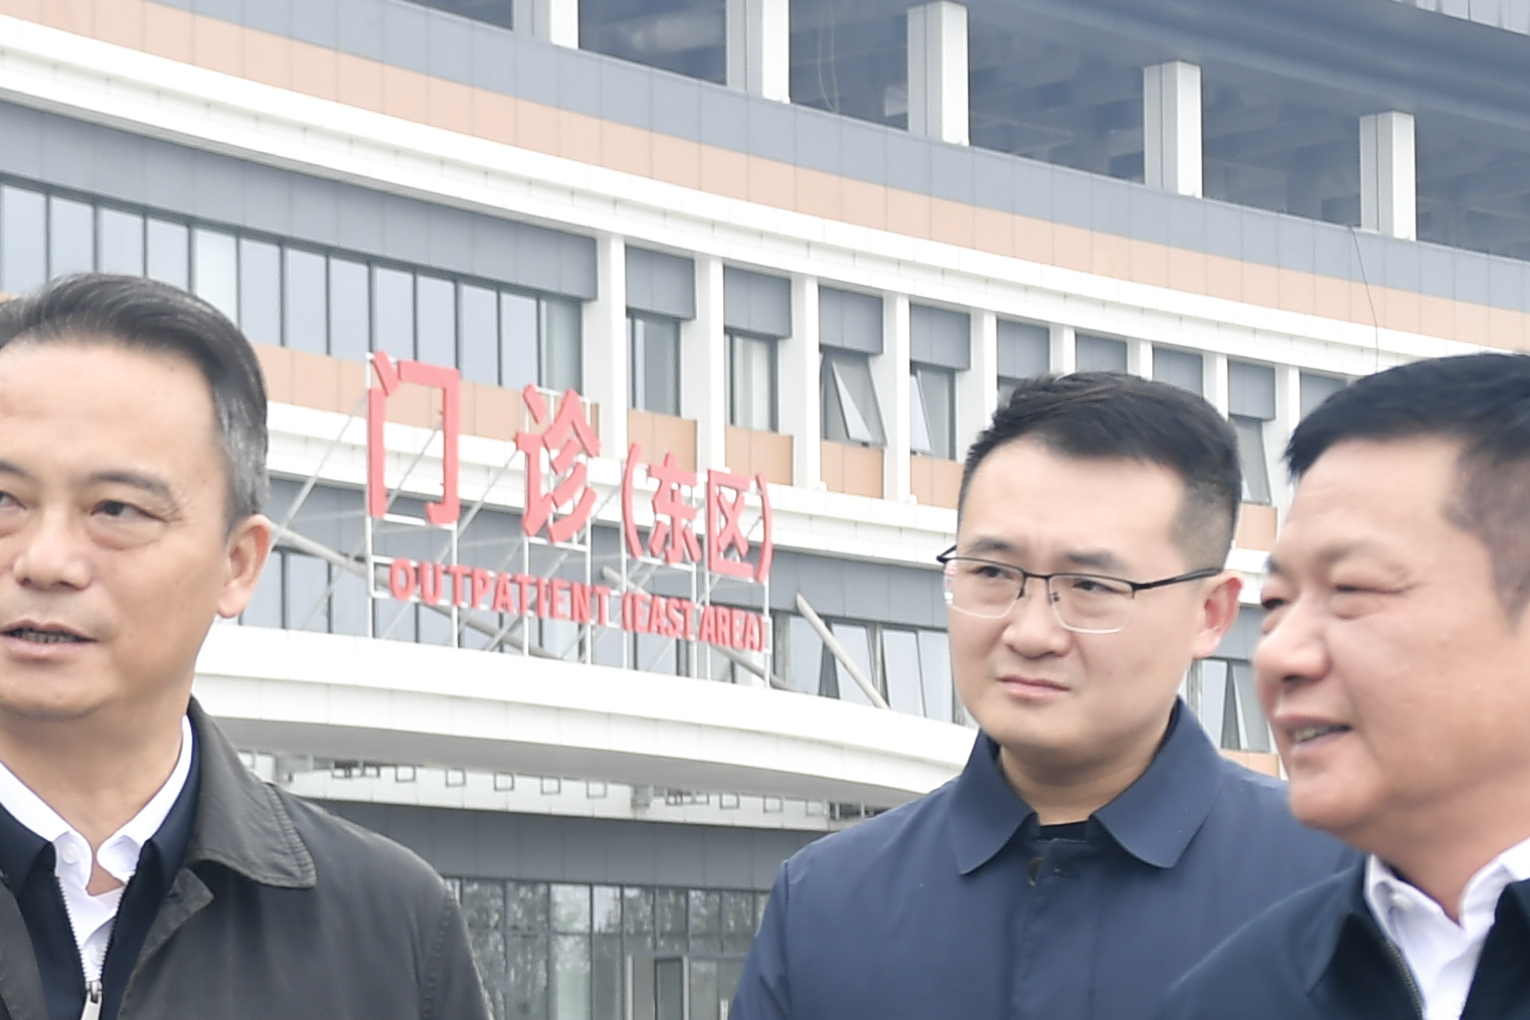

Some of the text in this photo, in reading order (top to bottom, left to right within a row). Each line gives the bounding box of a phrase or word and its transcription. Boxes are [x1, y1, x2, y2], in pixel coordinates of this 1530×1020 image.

[389, 558, 766, 652] OUTPATIENT (EAST AREA)
